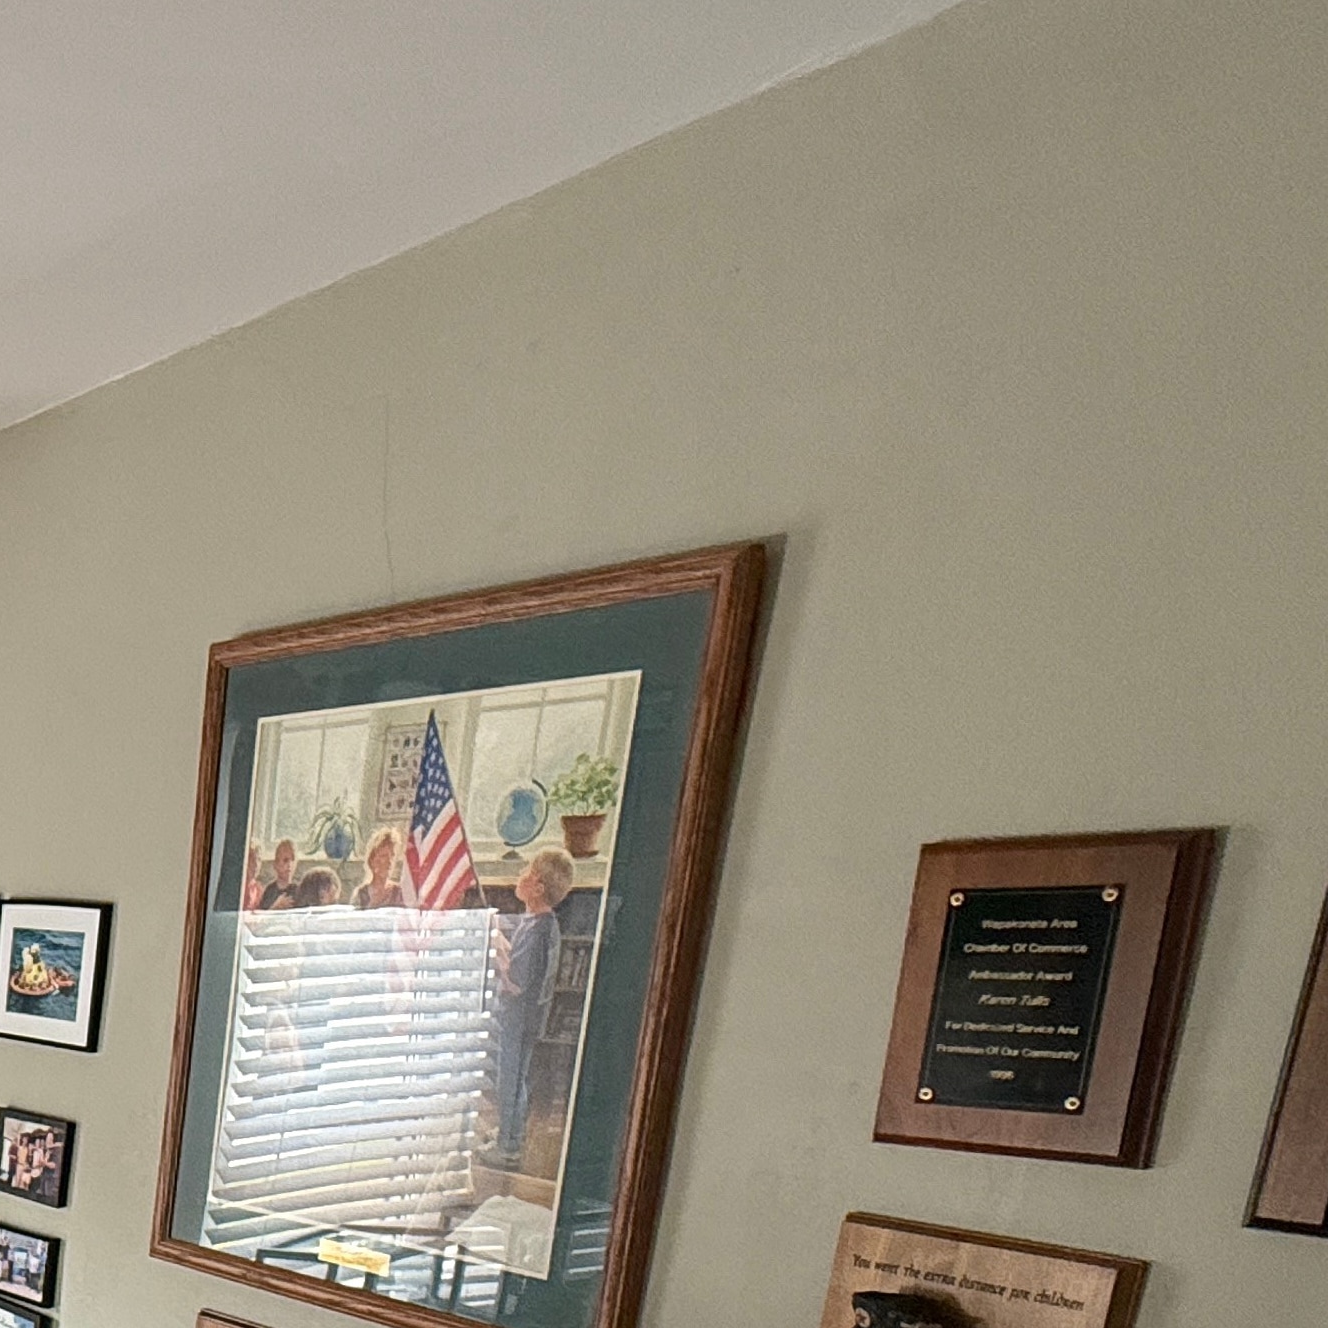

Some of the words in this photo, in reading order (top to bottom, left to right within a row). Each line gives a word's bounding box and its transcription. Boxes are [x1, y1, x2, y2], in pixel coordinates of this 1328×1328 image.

[1049, 918, 1078, 929] Area
[1029, 943, 1088, 954] Commerce
[1035, 971, 1074, 981] Award
[1016, 1023, 1055, 1034] Service
[1021, 1048, 1081, 1062] Community
[852, 1253, 871, 1269] You
[958, 1274, 1006, 1297] distance
[1033, 1288, 1086, 1312] children
